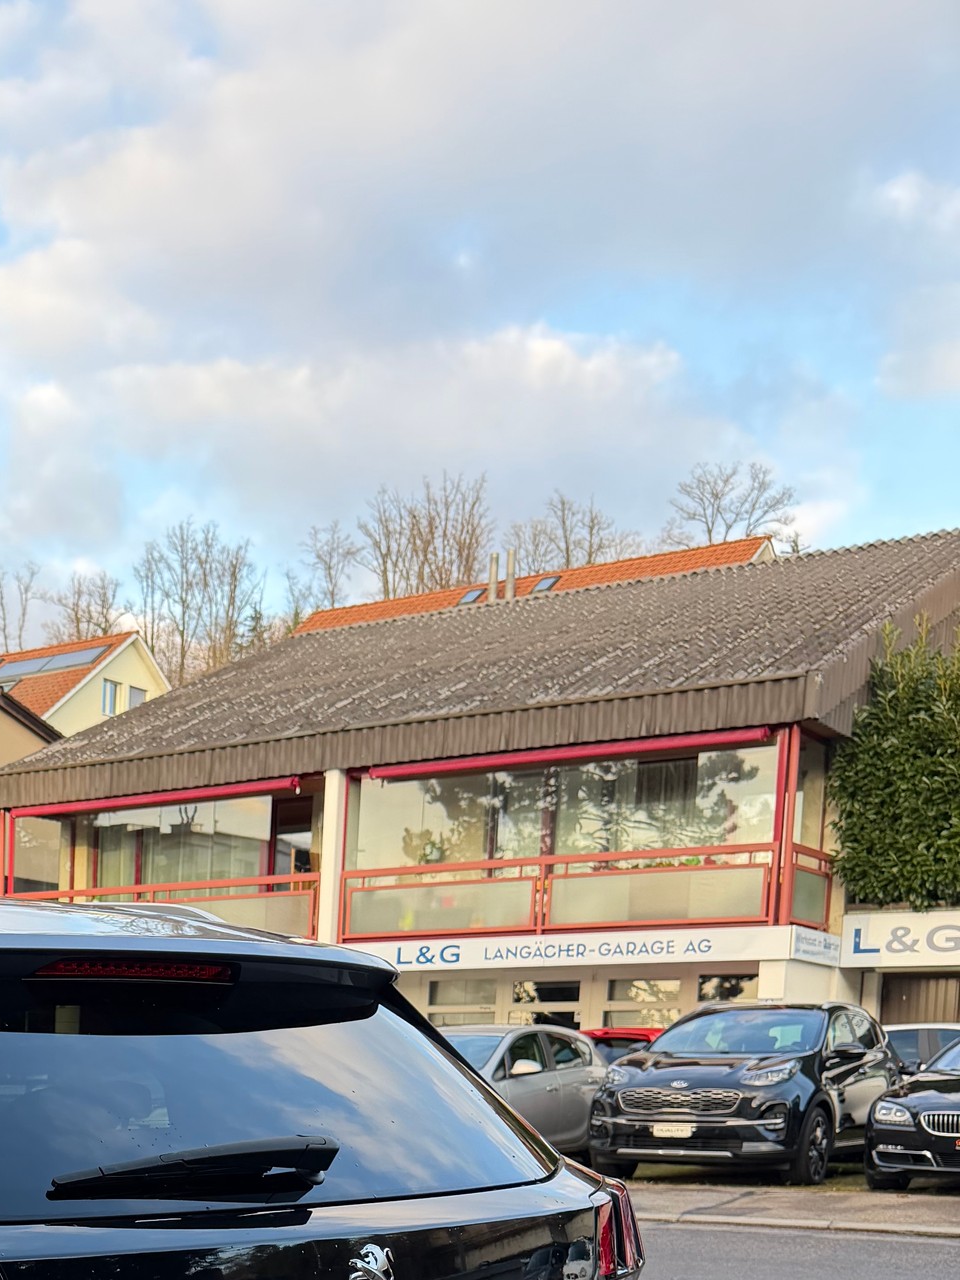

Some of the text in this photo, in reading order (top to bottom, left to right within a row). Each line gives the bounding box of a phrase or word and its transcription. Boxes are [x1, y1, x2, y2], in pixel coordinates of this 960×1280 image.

[396, 938, 713, 965] L&G LANGÄCHER-GARAGE AG
[853, 924, 960, 955] L&G
